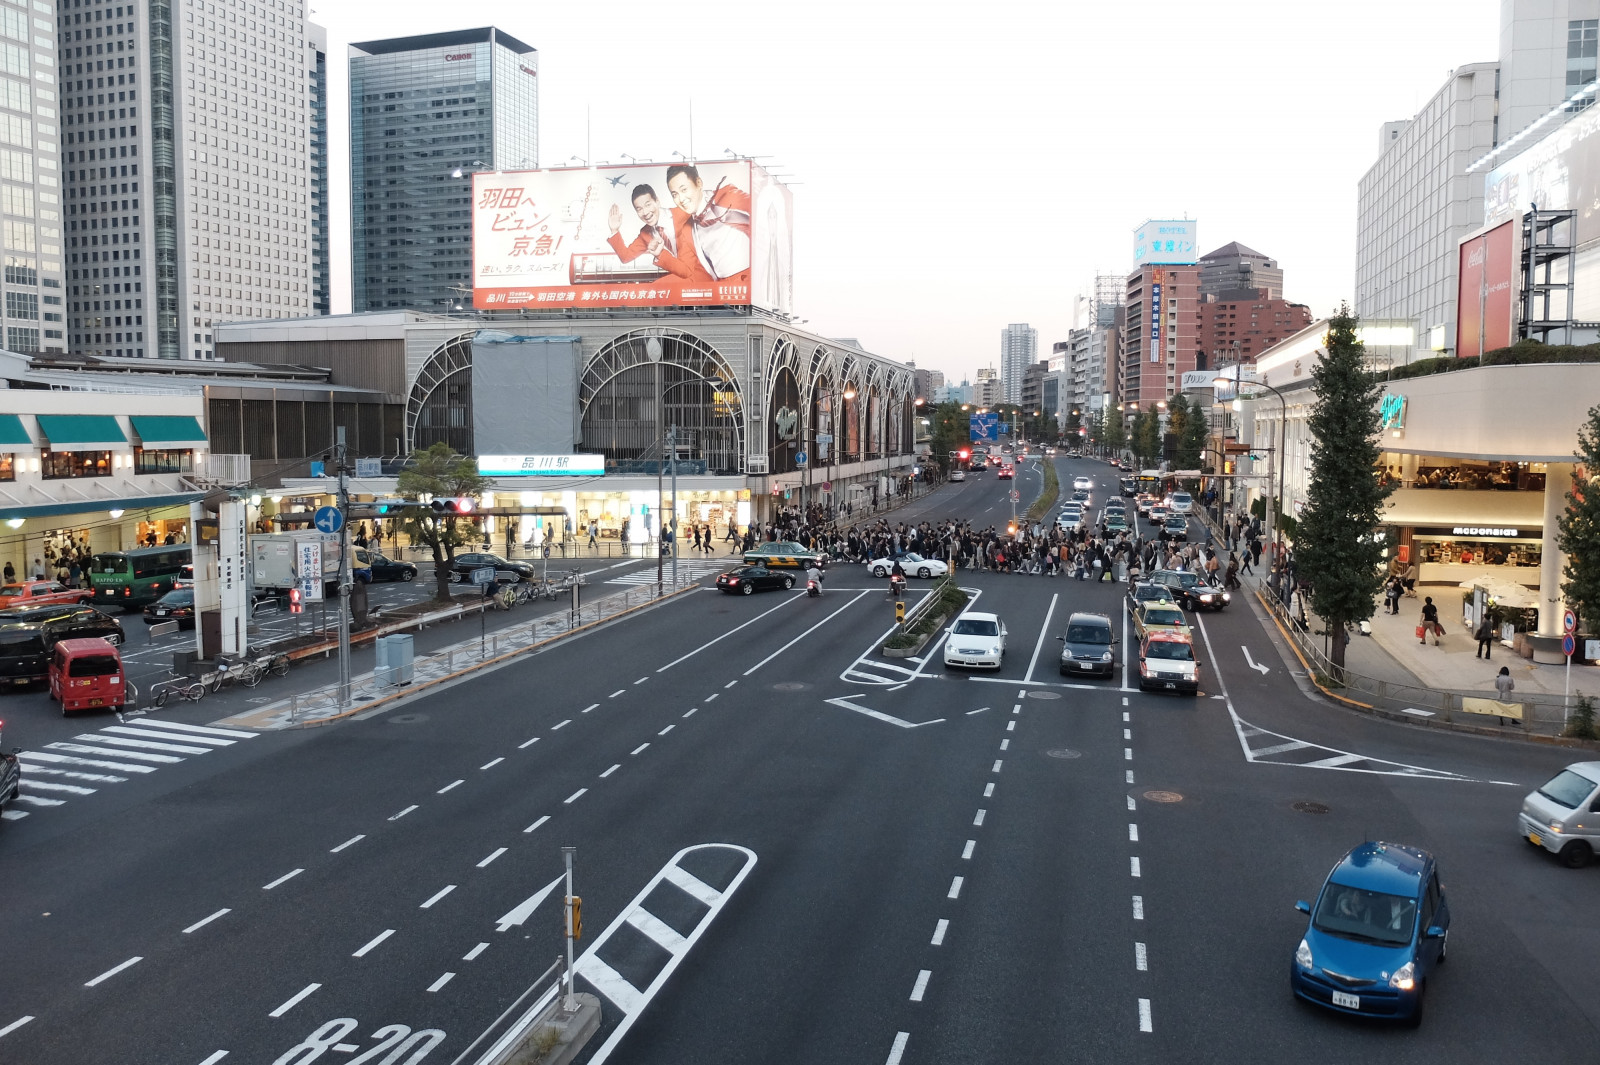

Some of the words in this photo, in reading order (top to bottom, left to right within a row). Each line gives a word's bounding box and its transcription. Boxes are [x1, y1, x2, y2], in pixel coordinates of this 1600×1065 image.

[445, 53, 472, 62] Canon
[478, 187, 536, 209] 羽田へ
[491, 210, 552, 232] ビュン。
[508, 233, 564, 257] 京急!
[486, 293, 506, 303] 品川
[537, 291, 576, 302] 羽田空港
[581, 289, 671, 301] 海外も国内も京急で!
[719, 286, 747, 294] KEIKYU
[521, 456, 570, 468] 品川駅
